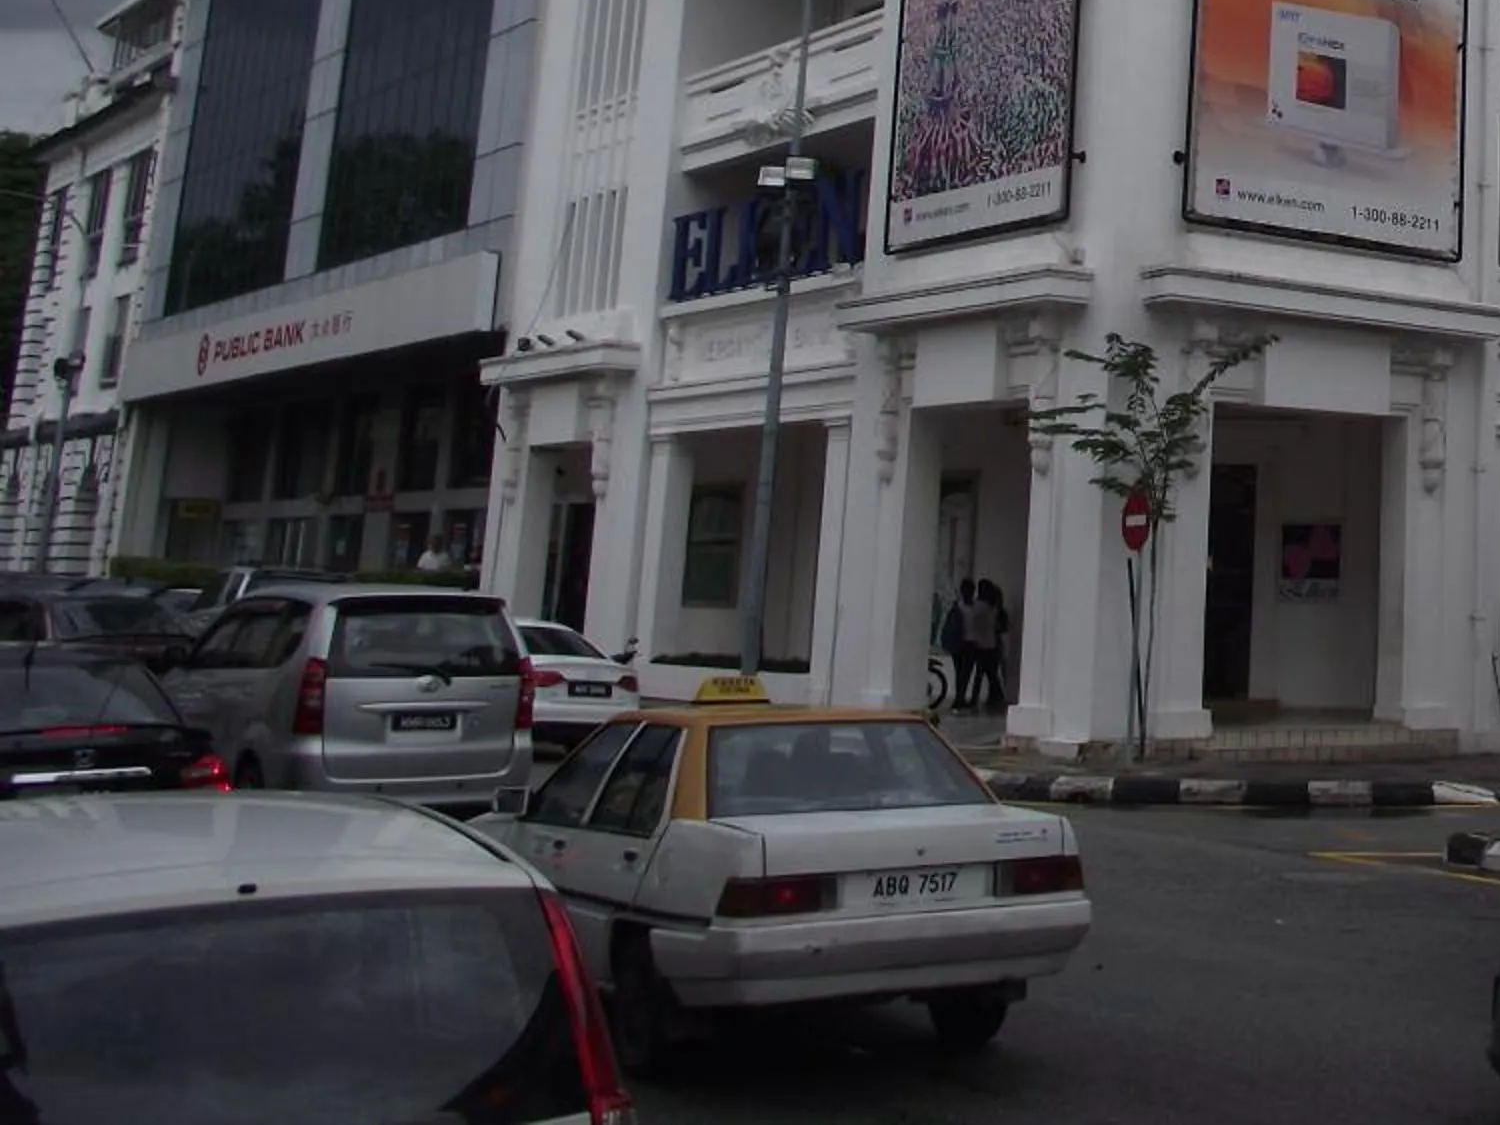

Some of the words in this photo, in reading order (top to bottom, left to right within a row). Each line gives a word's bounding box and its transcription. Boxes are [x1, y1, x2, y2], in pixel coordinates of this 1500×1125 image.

[1352, 205, 1440, 232] 1-300-88-2211
[213, 331, 261, 363] PUBLIC
[264, 319, 306, 351] BANK
[873, 875, 910, 897] ABQ
[919, 872, 958, 895] 7517
